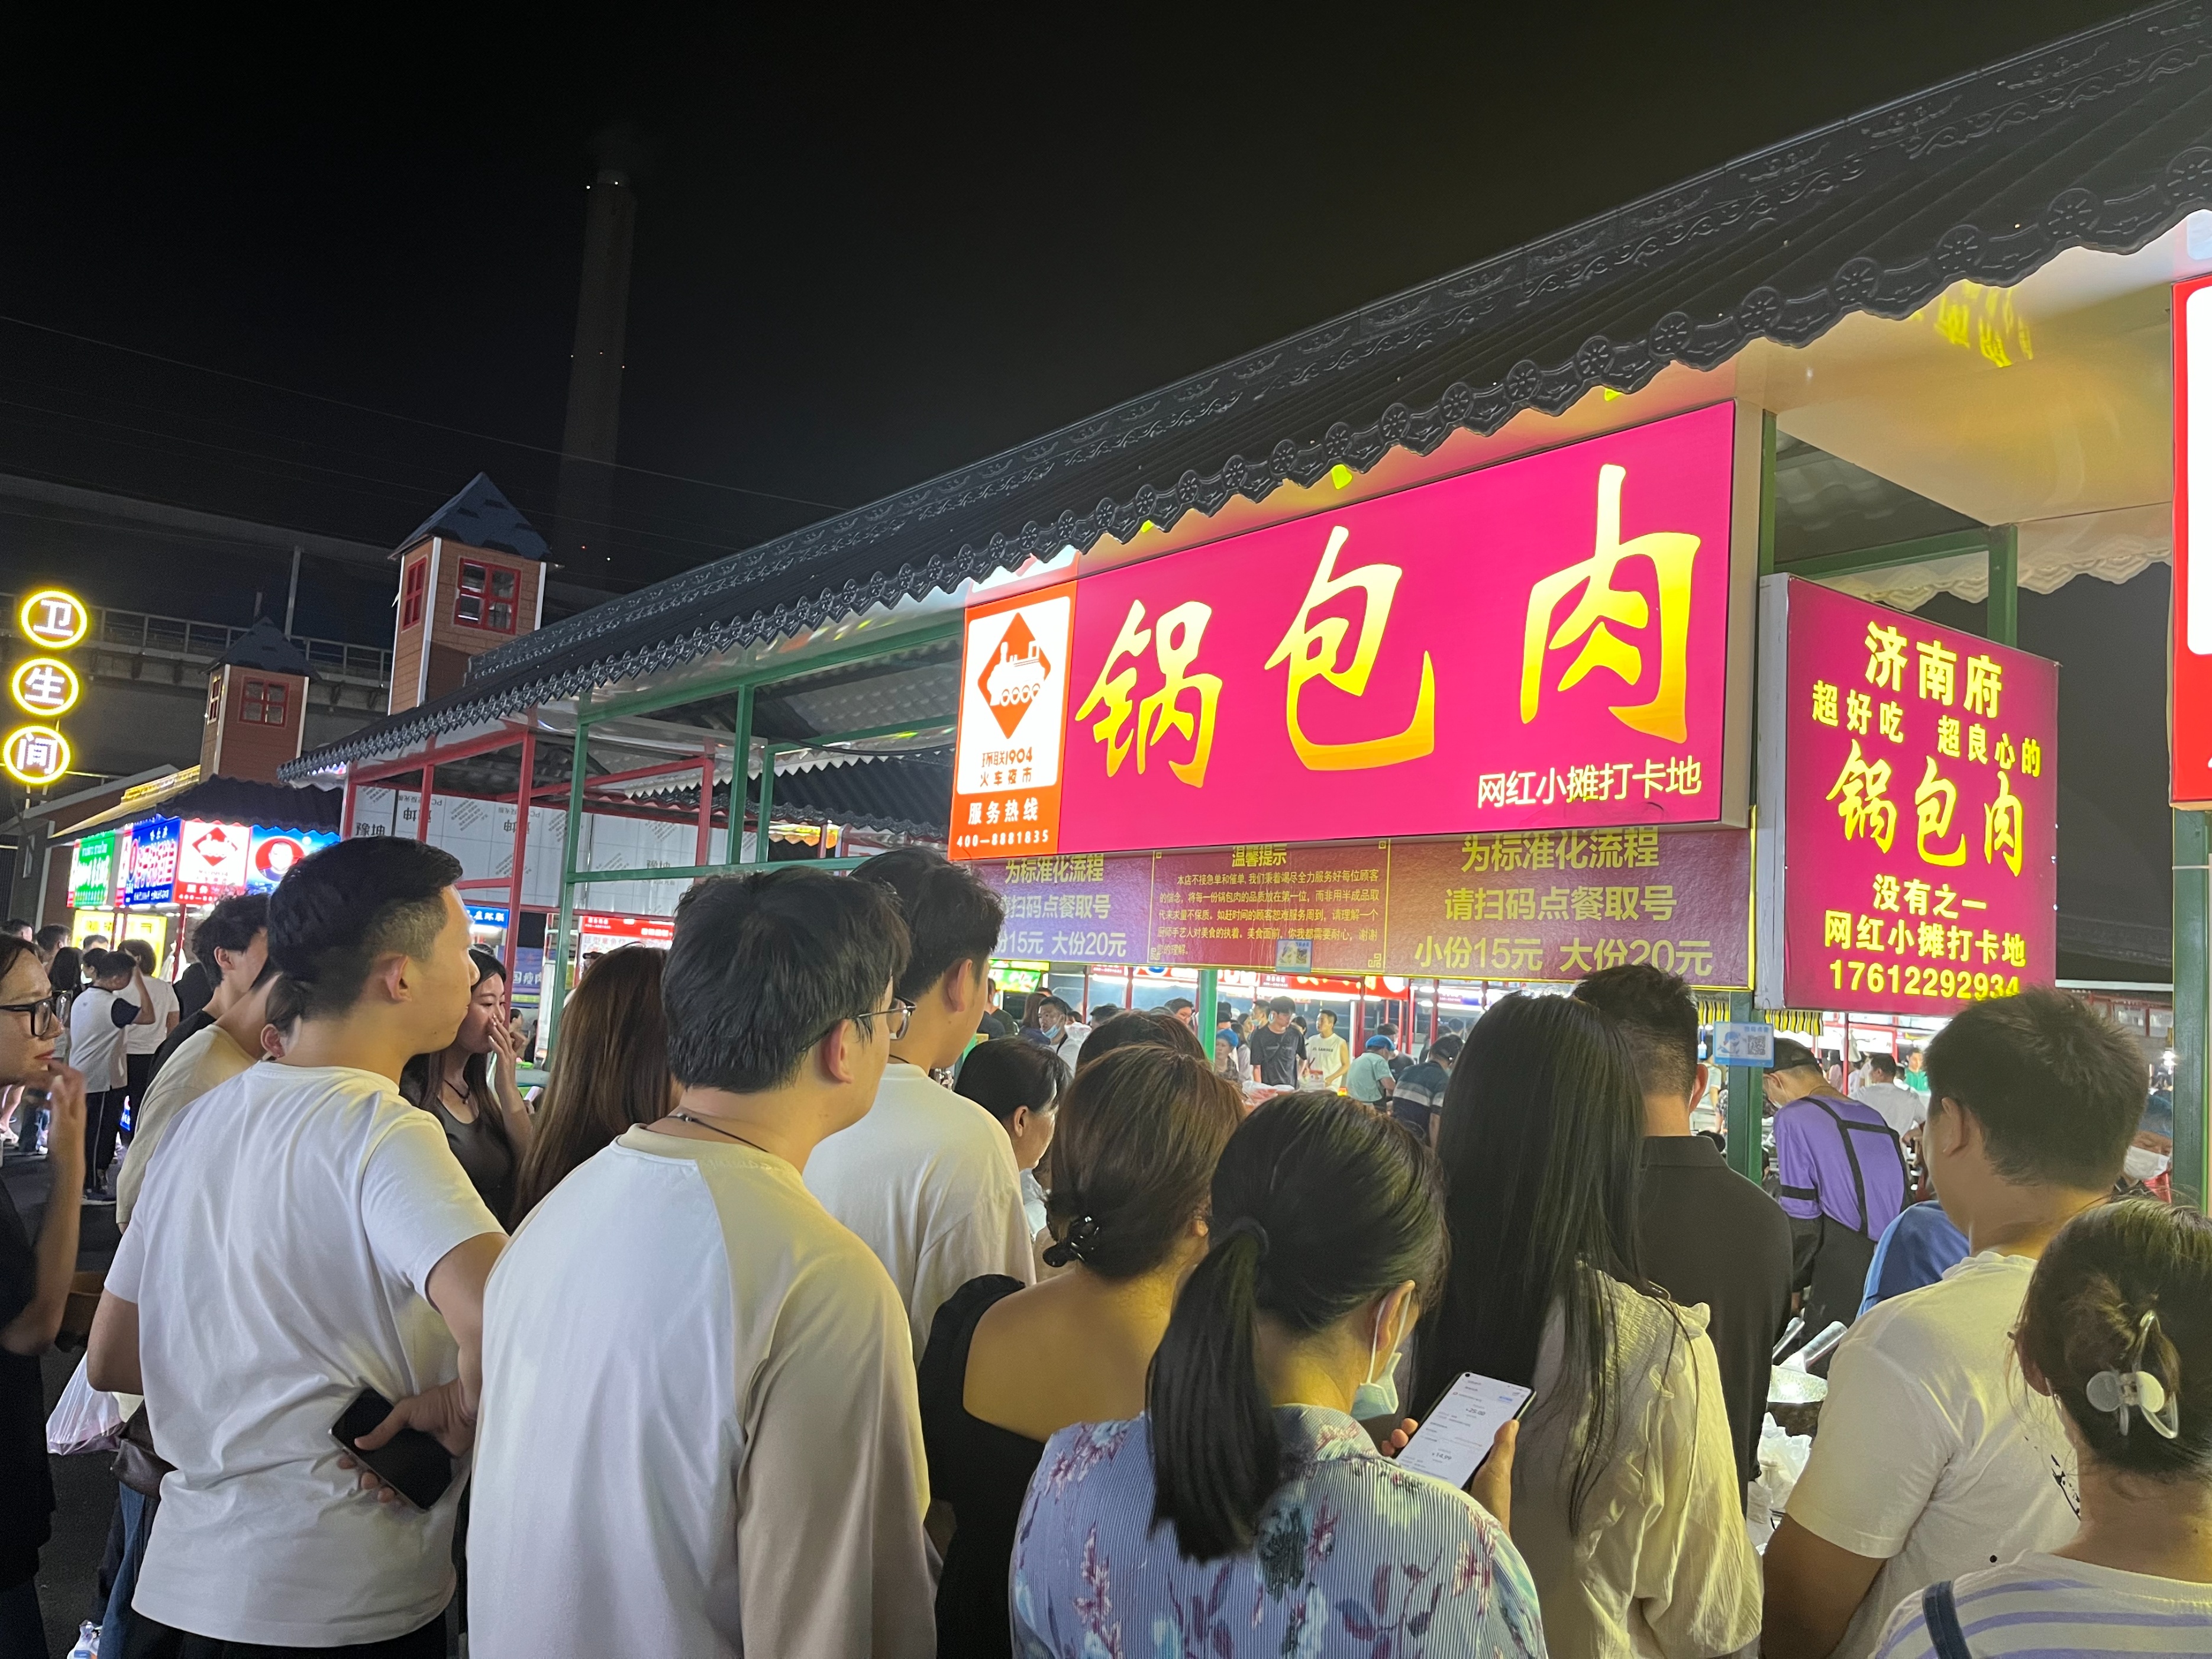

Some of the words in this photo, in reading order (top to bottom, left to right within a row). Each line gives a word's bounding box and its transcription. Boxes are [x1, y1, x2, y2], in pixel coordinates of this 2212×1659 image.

[1075, 463, 1701, 789] 锅包肉
[17, 599, 74, 775] 卫生间
[1864, 621, 2003, 718] 济南府
[1811, 680, 1904, 743] 超好吃
[1936, 715, 2041, 777] 超良心的
[980, 767, 1032, 787] 火车夜市
[981, 746, 1032, 768] 环联1904
[1477, 755, 1702, 808] 网红小摊打卡地
[967, 796, 1038, 825] 服务热线
[1825, 739, 2024, 876] 锅包肉
[1005, 853, 1105, 884] 为标准化流程
[1232, 844, 1287, 867] 温馨提示
[1461, 825, 1659, 872] 为标准化流程
[1444, 885, 1677, 921] 请扫码点餐取号
[1872, 873, 1987, 919] 没有之一
[1051, 931, 1126, 957] 大份20元
[1415, 935, 1543, 972] 小份15元
[1559, 937, 1713, 977] 大份20元
[1824, 910, 2026, 967] 网红小摊打卡地
[1830, 960, 2020, 1001] 17612292934
